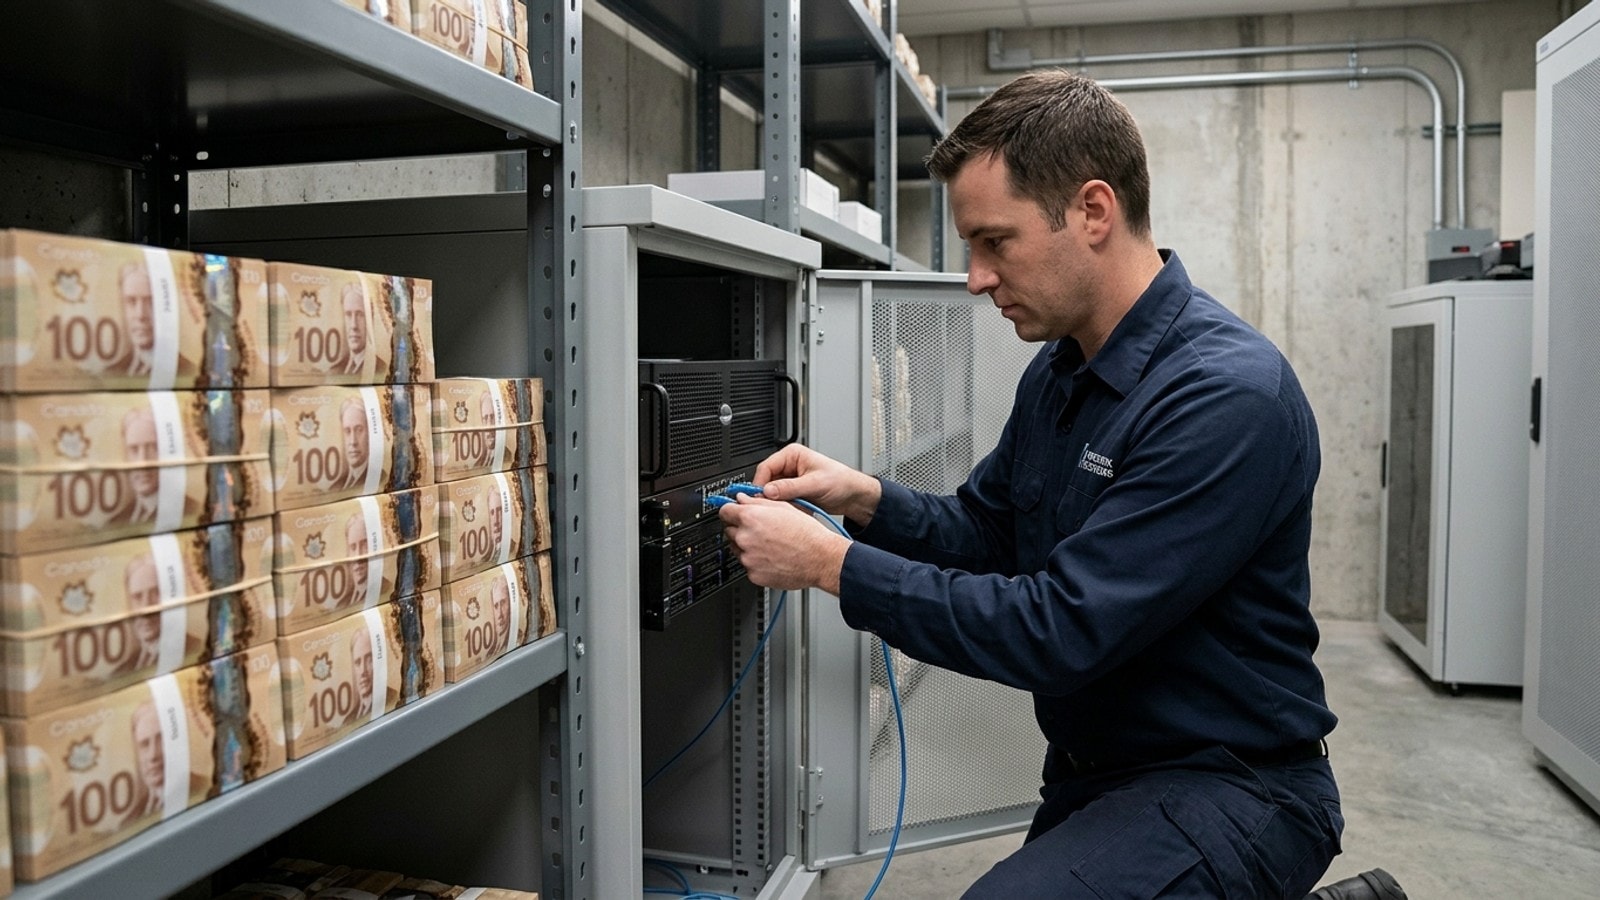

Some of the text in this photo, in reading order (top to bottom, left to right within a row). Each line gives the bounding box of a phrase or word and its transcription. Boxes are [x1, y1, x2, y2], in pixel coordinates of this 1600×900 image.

[431, 3, 462, 43] 100
[46, 315, 120, 360] 100
[294, 327, 341, 363] 100
[293, 446, 340, 485] 100
[452, 430, 481, 461] 100
[48, 469, 123, 519] 100
[460, 526, 489, 560] 100
[301, 565, 346, 607] 100
[53, 622, 127, 677] 100
[464, 621, 493, 658] 100
[309, 681, 351, 728] 100
[59, 771, 134, 835] 100
